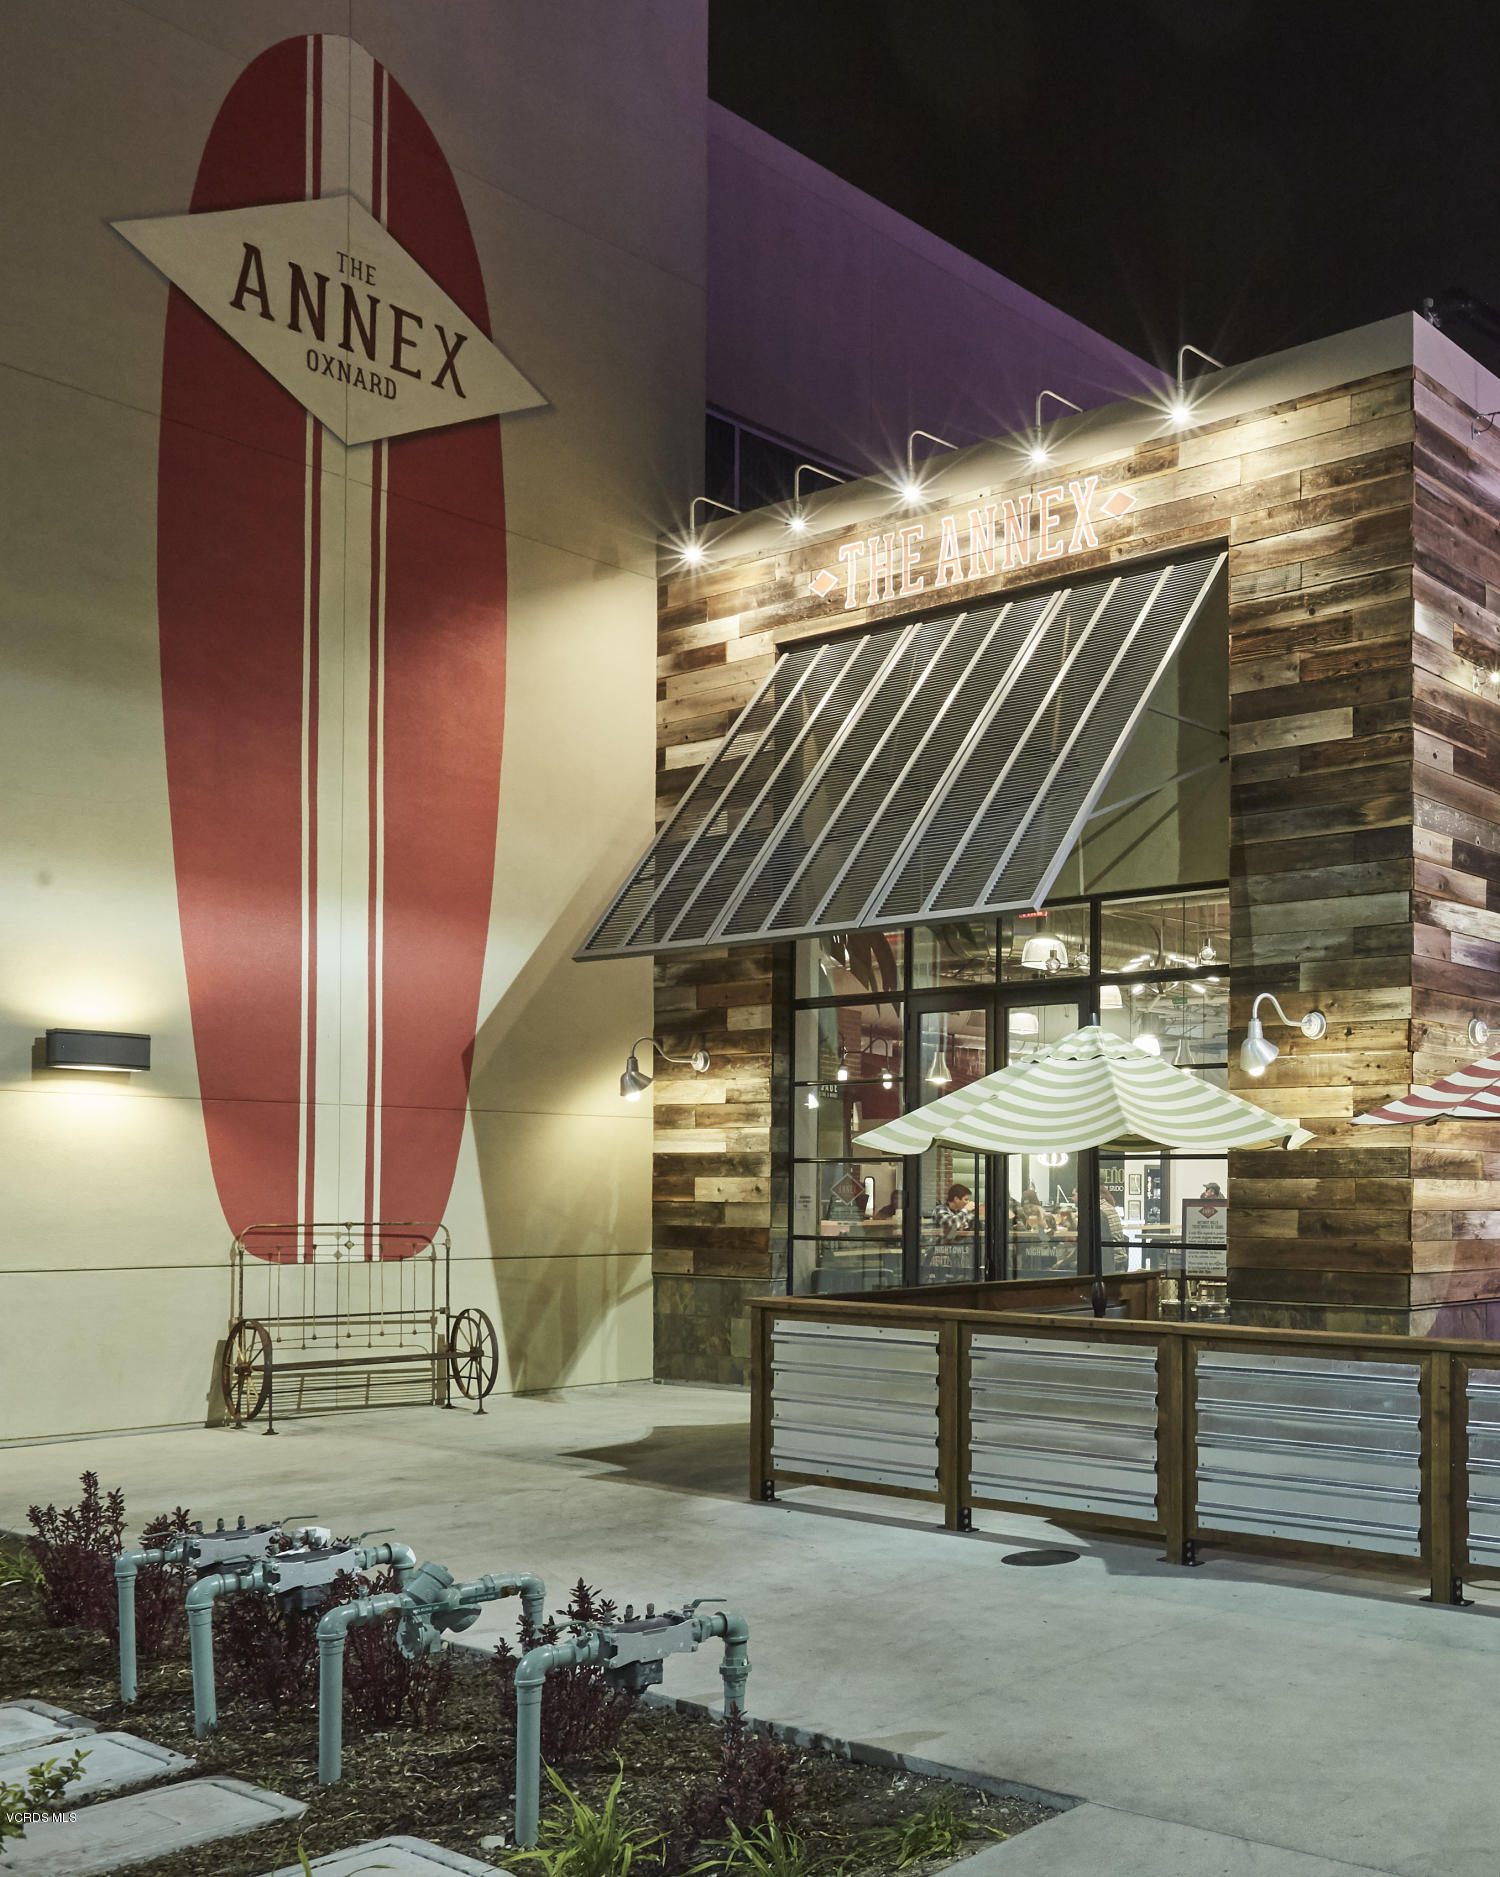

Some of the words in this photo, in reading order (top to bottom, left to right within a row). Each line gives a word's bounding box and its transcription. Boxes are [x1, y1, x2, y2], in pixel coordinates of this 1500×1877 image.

[336, 251, 376, 286] THE
[229, 242, 468, 399] ANNEX
[306, 349, 397, 400] OXNARD
[839, 524, 924, 609] THE
[935, 475, 1099, 588] ANNEX
